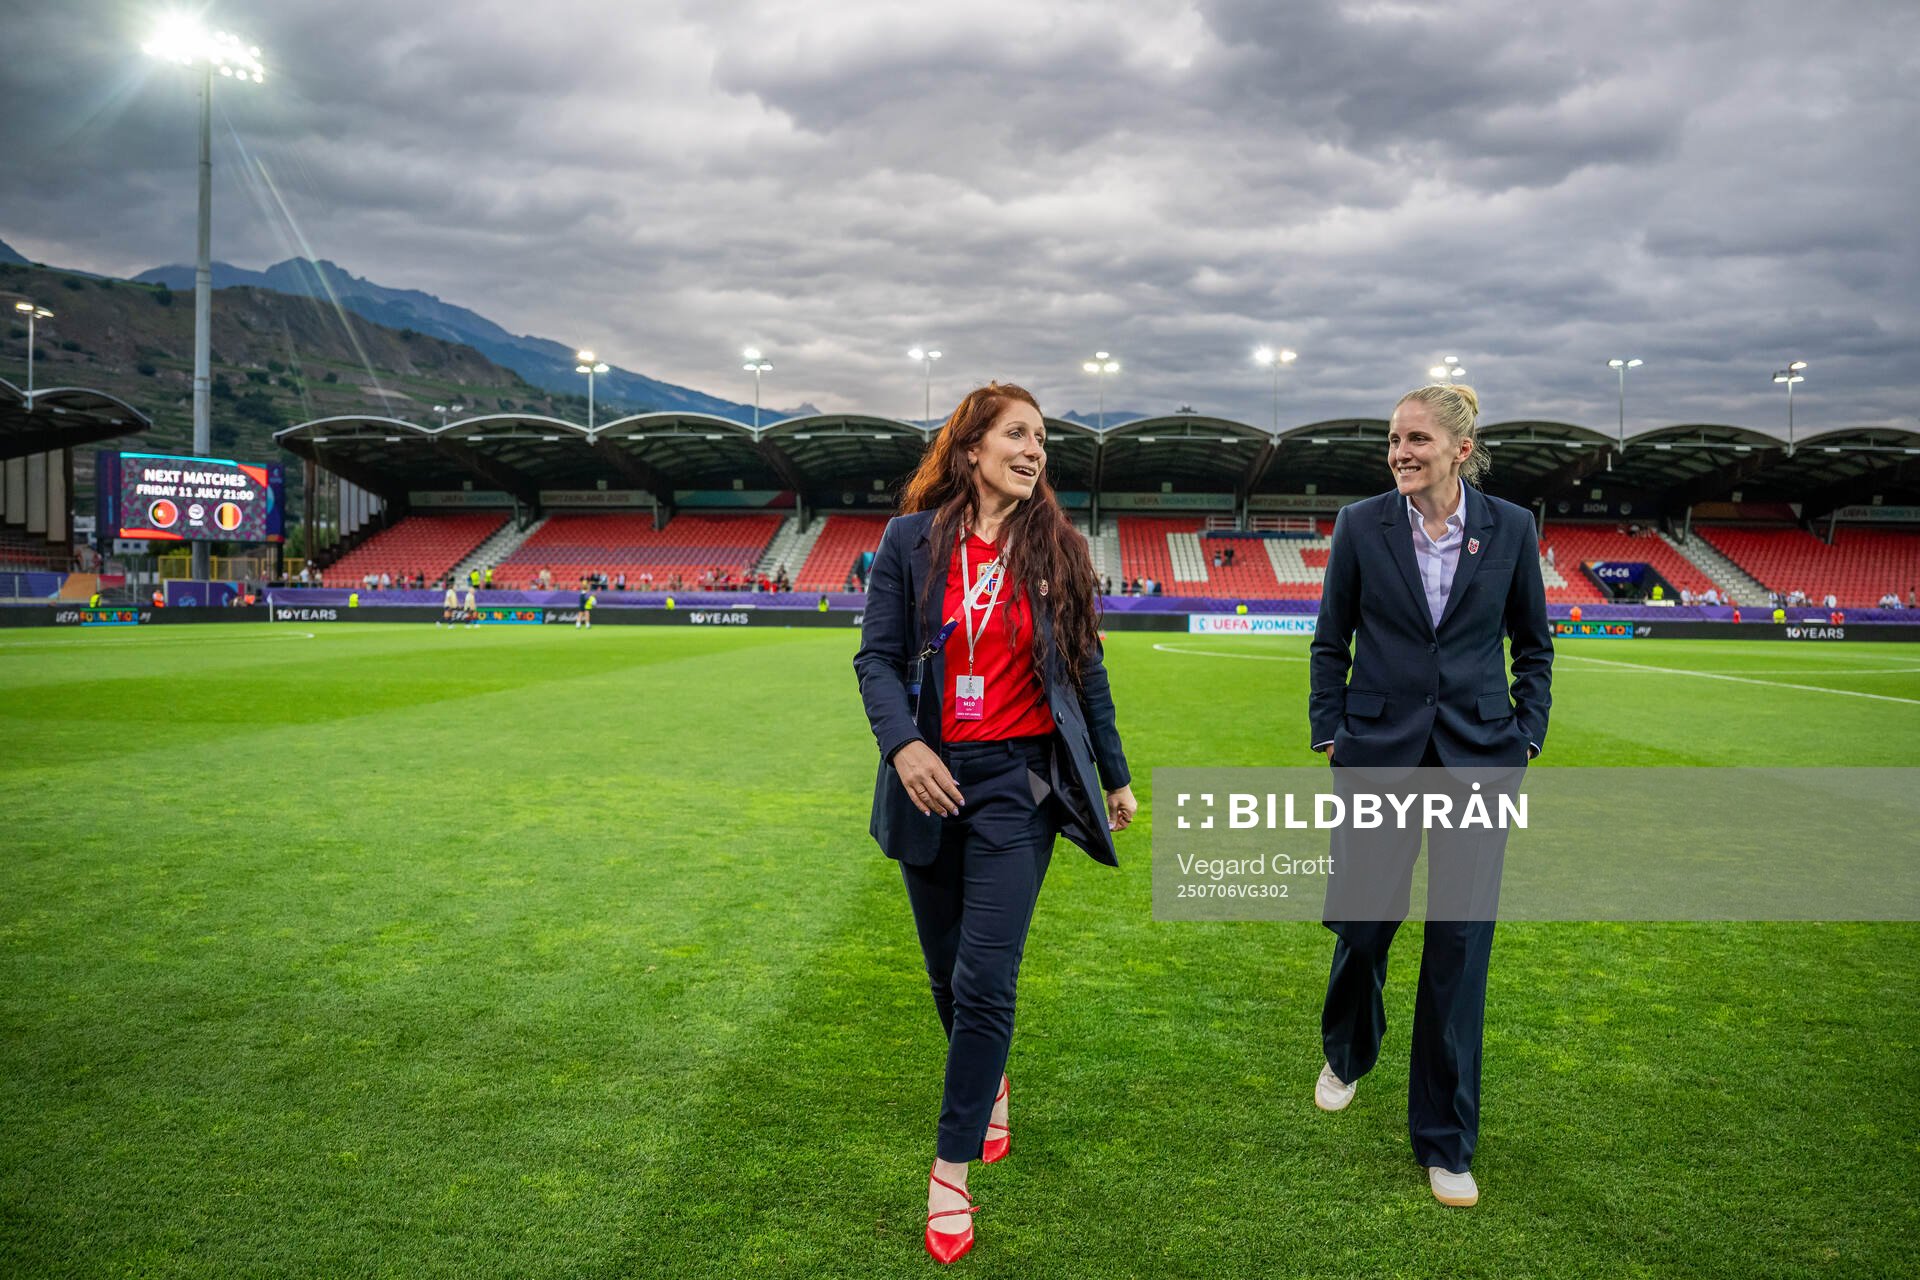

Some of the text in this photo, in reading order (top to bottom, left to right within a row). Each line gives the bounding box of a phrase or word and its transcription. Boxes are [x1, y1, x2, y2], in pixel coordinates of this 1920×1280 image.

[144, 468, 247, 488] NEXT MATCHES
[136, 484, 255, 501] FRIDAY 11 JULY 21:00
[1583, 503, 1609, 513] SION
[1599, 567, 1630, 578] C4-C6
[56, 611, 79, 623] UEFA
[80, 611, 138, 622] FOUNDATION
[1213, 619, 1316, 631] UEFA WOMEN'S
[1556, 626, 1633, 636] FOUNDATION
